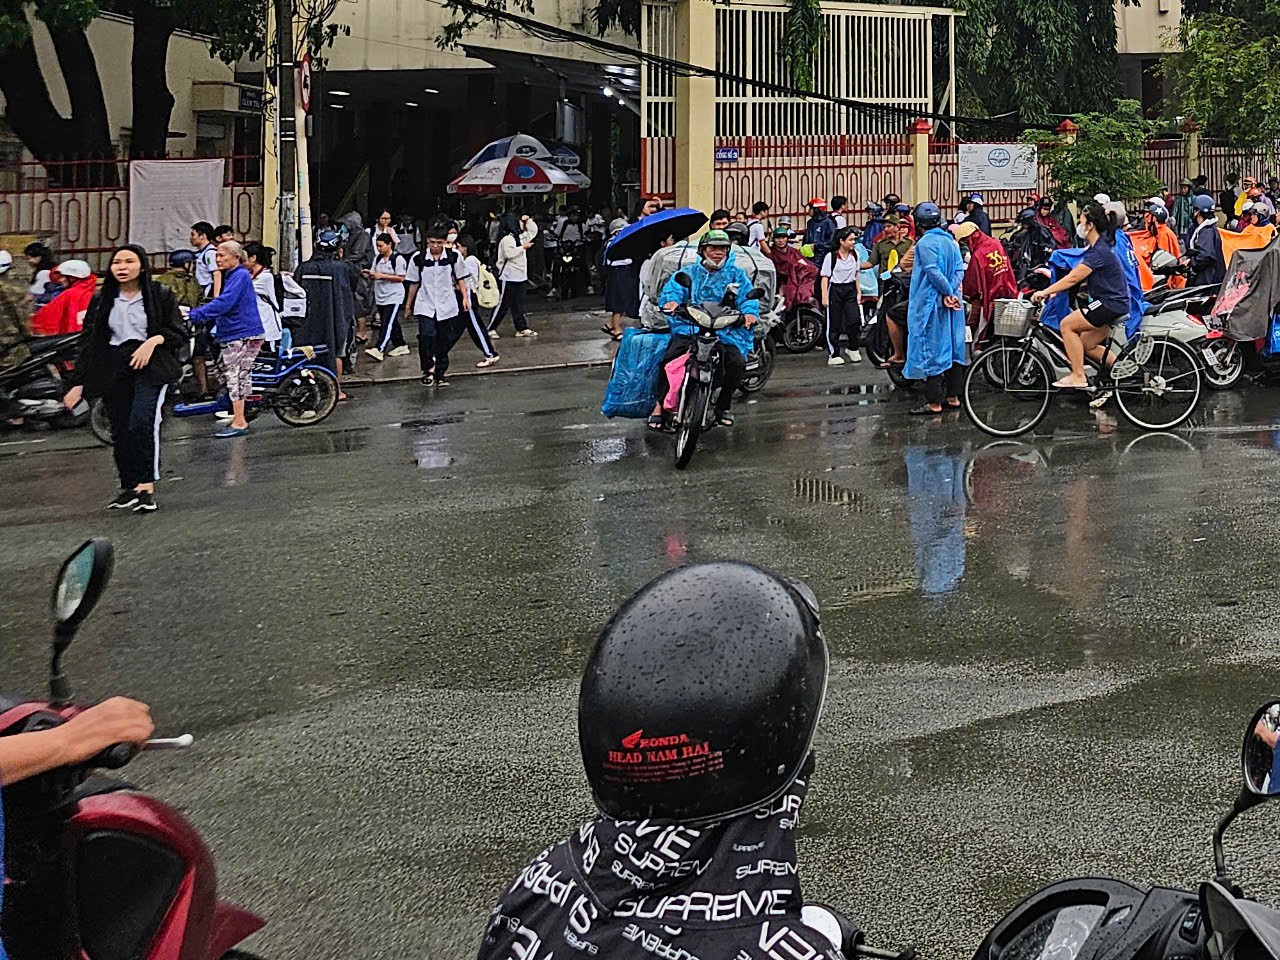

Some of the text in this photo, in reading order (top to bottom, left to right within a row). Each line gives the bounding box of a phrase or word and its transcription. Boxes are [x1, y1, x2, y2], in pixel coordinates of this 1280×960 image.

[608, 751, 643, 763] HEAD
[647, 749, 679, 762] NAM
[613, 889, 793, 922] SUPREME
